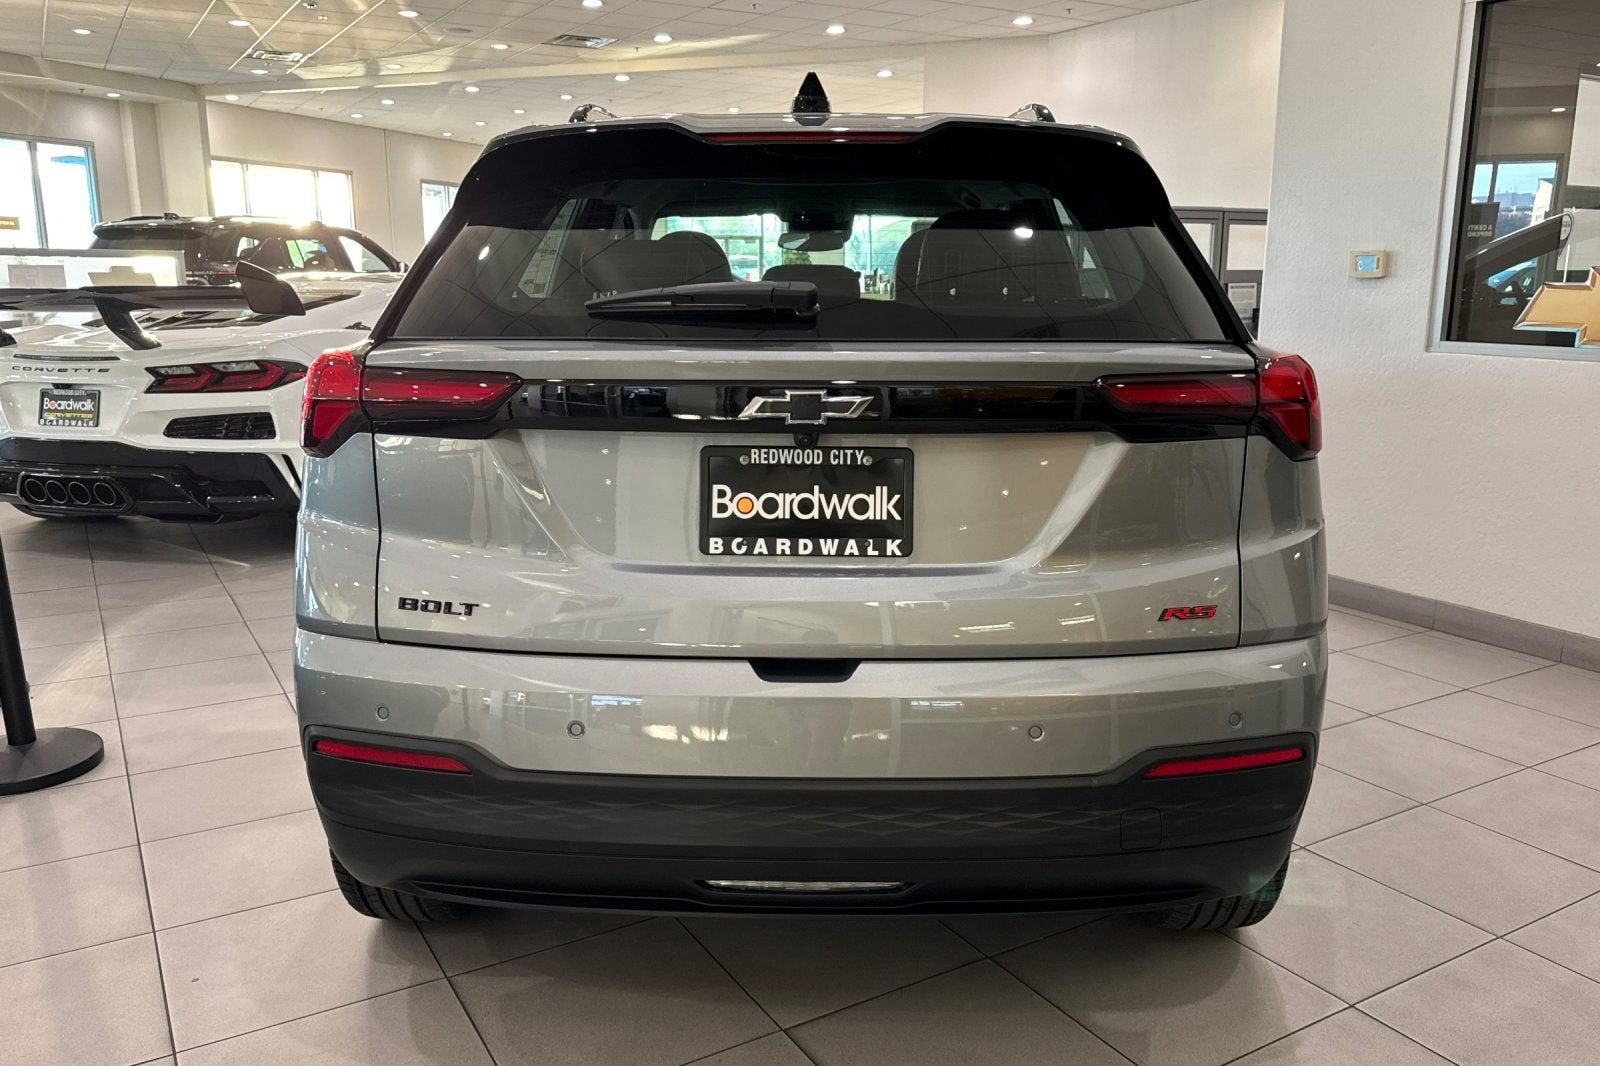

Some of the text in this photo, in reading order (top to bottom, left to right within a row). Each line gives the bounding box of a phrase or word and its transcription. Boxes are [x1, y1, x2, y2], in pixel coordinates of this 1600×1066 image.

[43, 398, 94, 411] Boardwalk
[750, 448, 865, 465] REDWOOD CITY
[711, 484, 902, 521] Boardwalk
[709, 537, 903, 556] BOARDWALK
[398, 596, 480, 617] BOLT
[1157, 604, 1218, 622] RS
